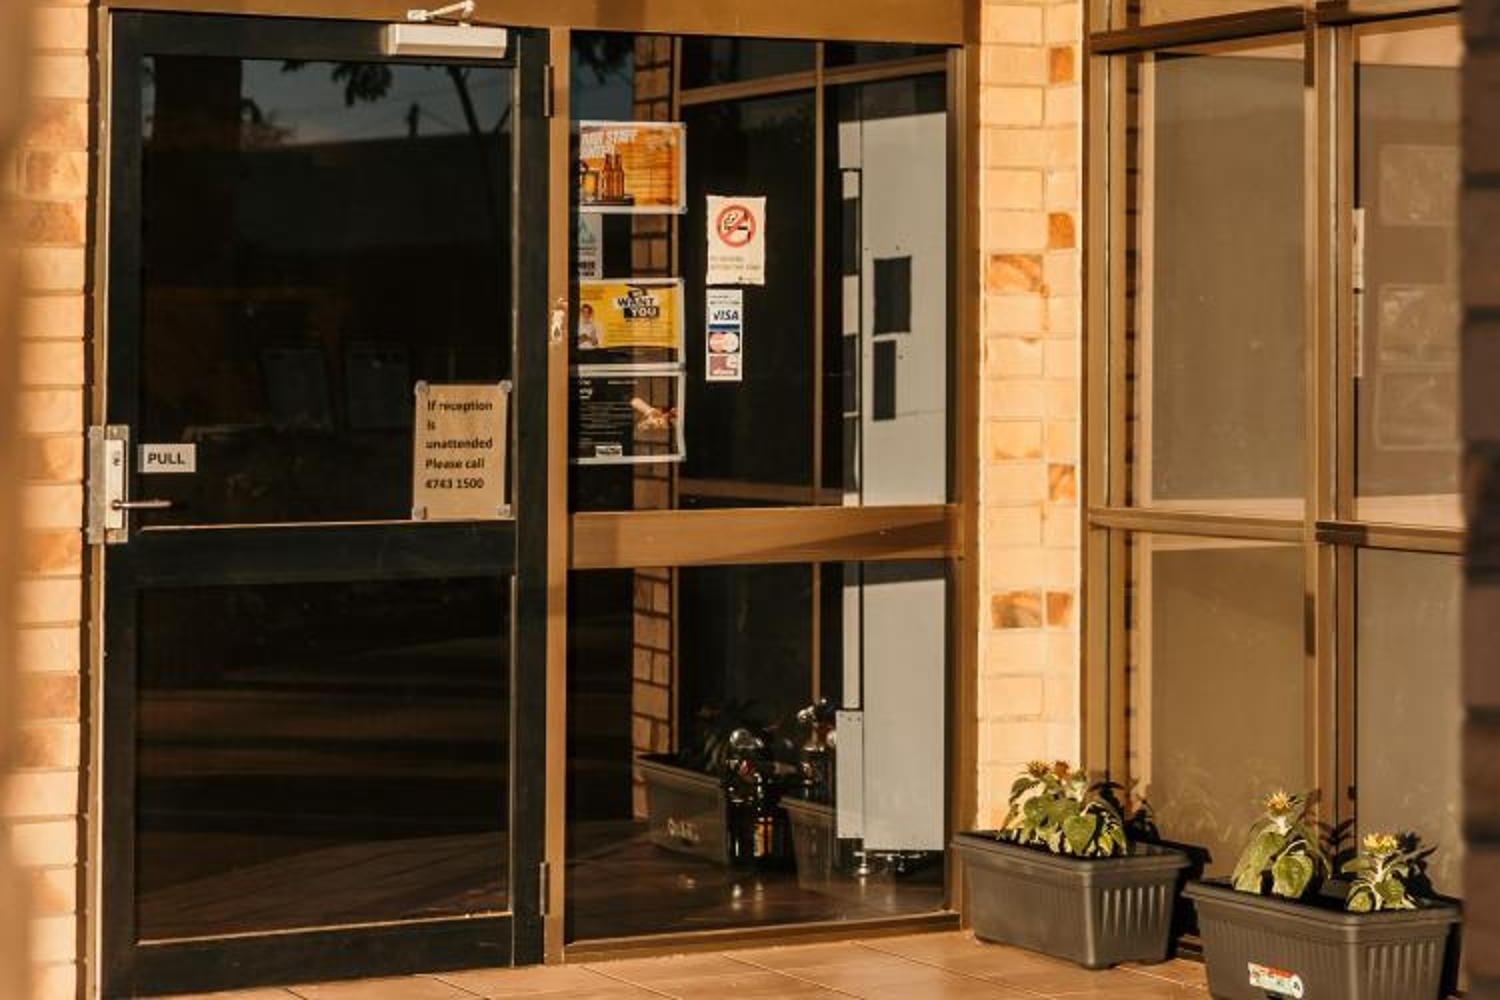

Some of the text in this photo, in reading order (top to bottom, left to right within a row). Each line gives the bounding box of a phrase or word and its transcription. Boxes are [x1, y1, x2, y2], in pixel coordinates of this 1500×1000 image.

[617, 297, 654, 307] WANT
[631, 306, 658, 317] YOU
[712, 310, 740, 321] VISA
[439, 400, 493, 413] reception
[425, 436, 493, 449] unattended
[147, 452, 186, 465] PULL
[425, 458, 485, 469] Please call
[457, 477, 485, 489] 1500
